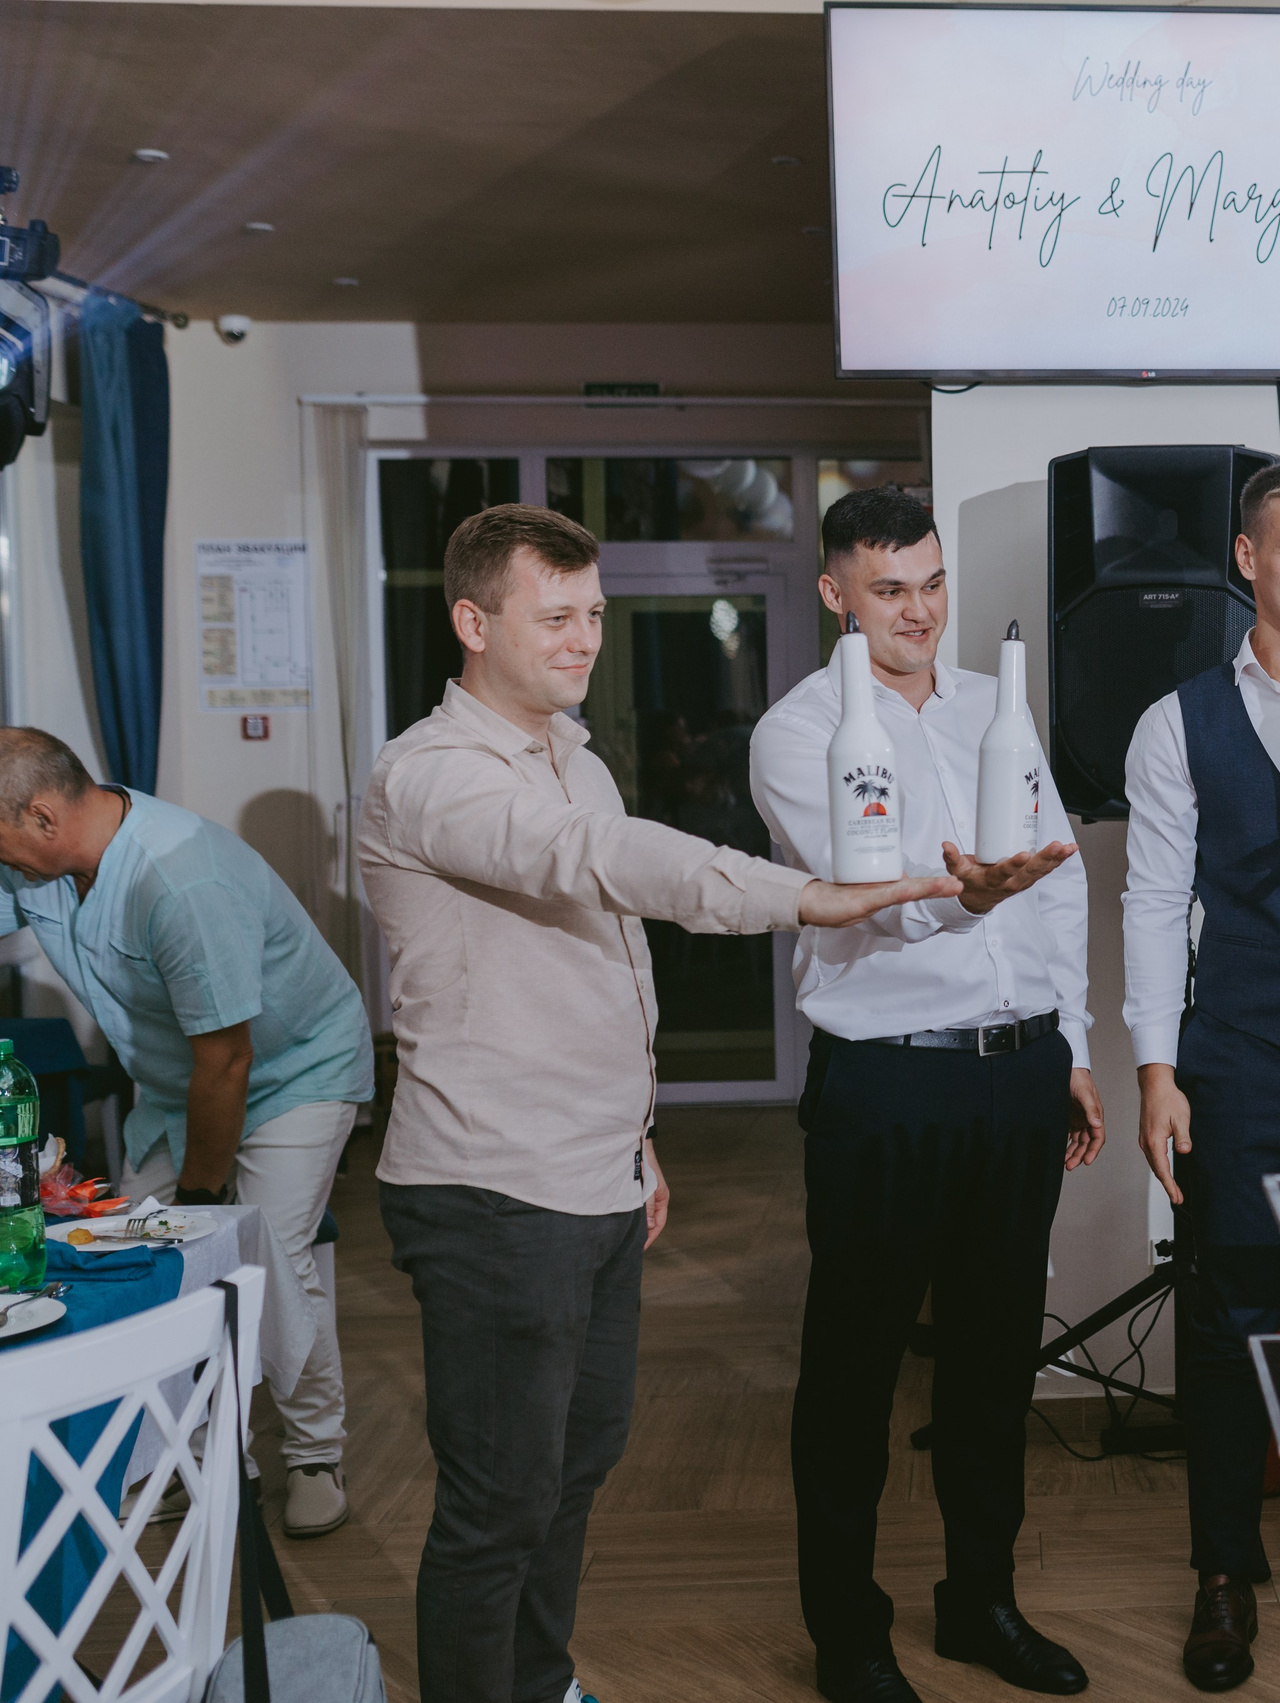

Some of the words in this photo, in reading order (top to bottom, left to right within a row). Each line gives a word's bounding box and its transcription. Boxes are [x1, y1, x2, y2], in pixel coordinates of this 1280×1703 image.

[1072, 56, 1170, 114] Wedding
[1175, 60, 1214, 117] day
[1097, 177, 1125, 218] &
[1106, 296, 1189, 318] 07.09.2024
[843, 765, 894, 786] MALIBU
[846, 828, 878, 836] COCONUT
